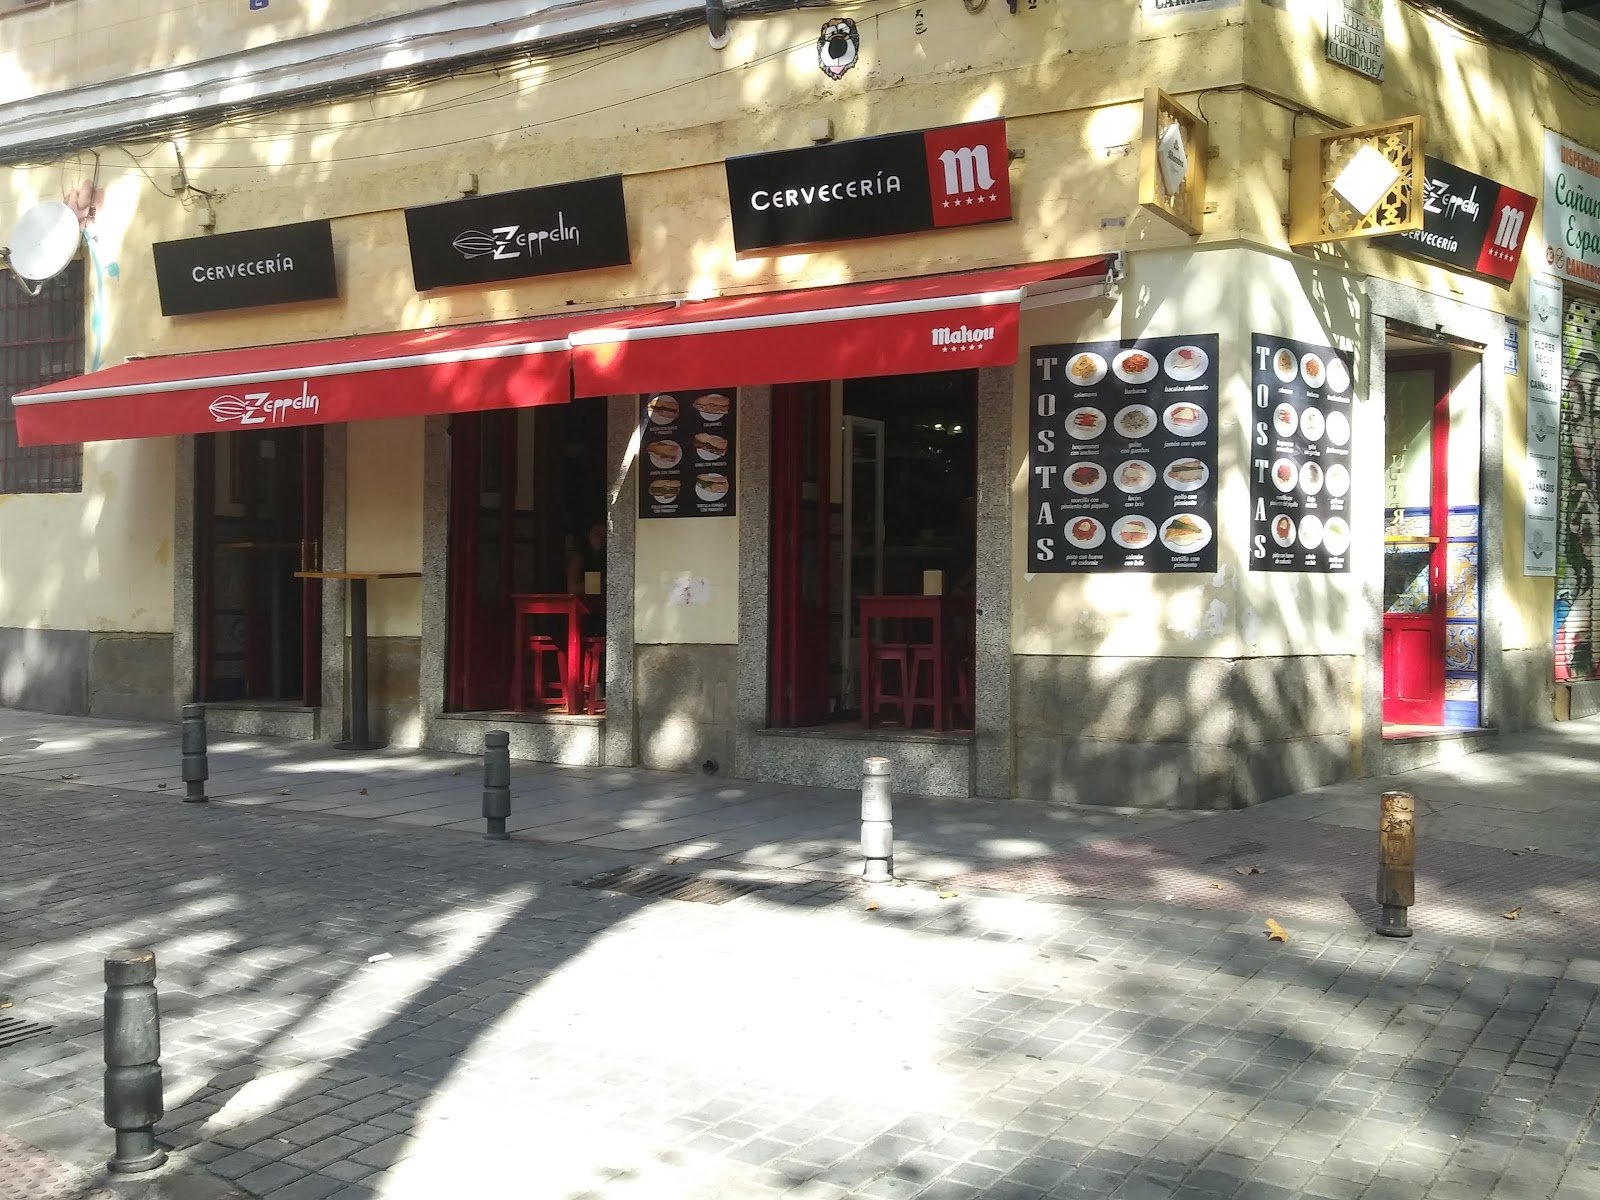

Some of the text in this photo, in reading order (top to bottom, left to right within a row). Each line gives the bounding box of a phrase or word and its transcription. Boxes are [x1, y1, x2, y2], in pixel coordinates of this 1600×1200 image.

[1330, 41, 1384, 78] CURTIDORES
[1335, 24, 1381, 57] RIBERA DE
[751, 171, 901, 211] CERVECERÍA
[1424, 179, 1480, 222] Zeppelin
[491, 211, 579, 260] Zeppelin
[192, 253, 294, 283] CERVECERÍA
[931, 325, 995, 345] Mahou
[241, 381, 319, 424] Zeppelin
[1035, 357, 1058, 561] TOSTAS
[1255, 346, 1270, 559] TOSTAS
[1537, 469, 1548, 479] DRY
